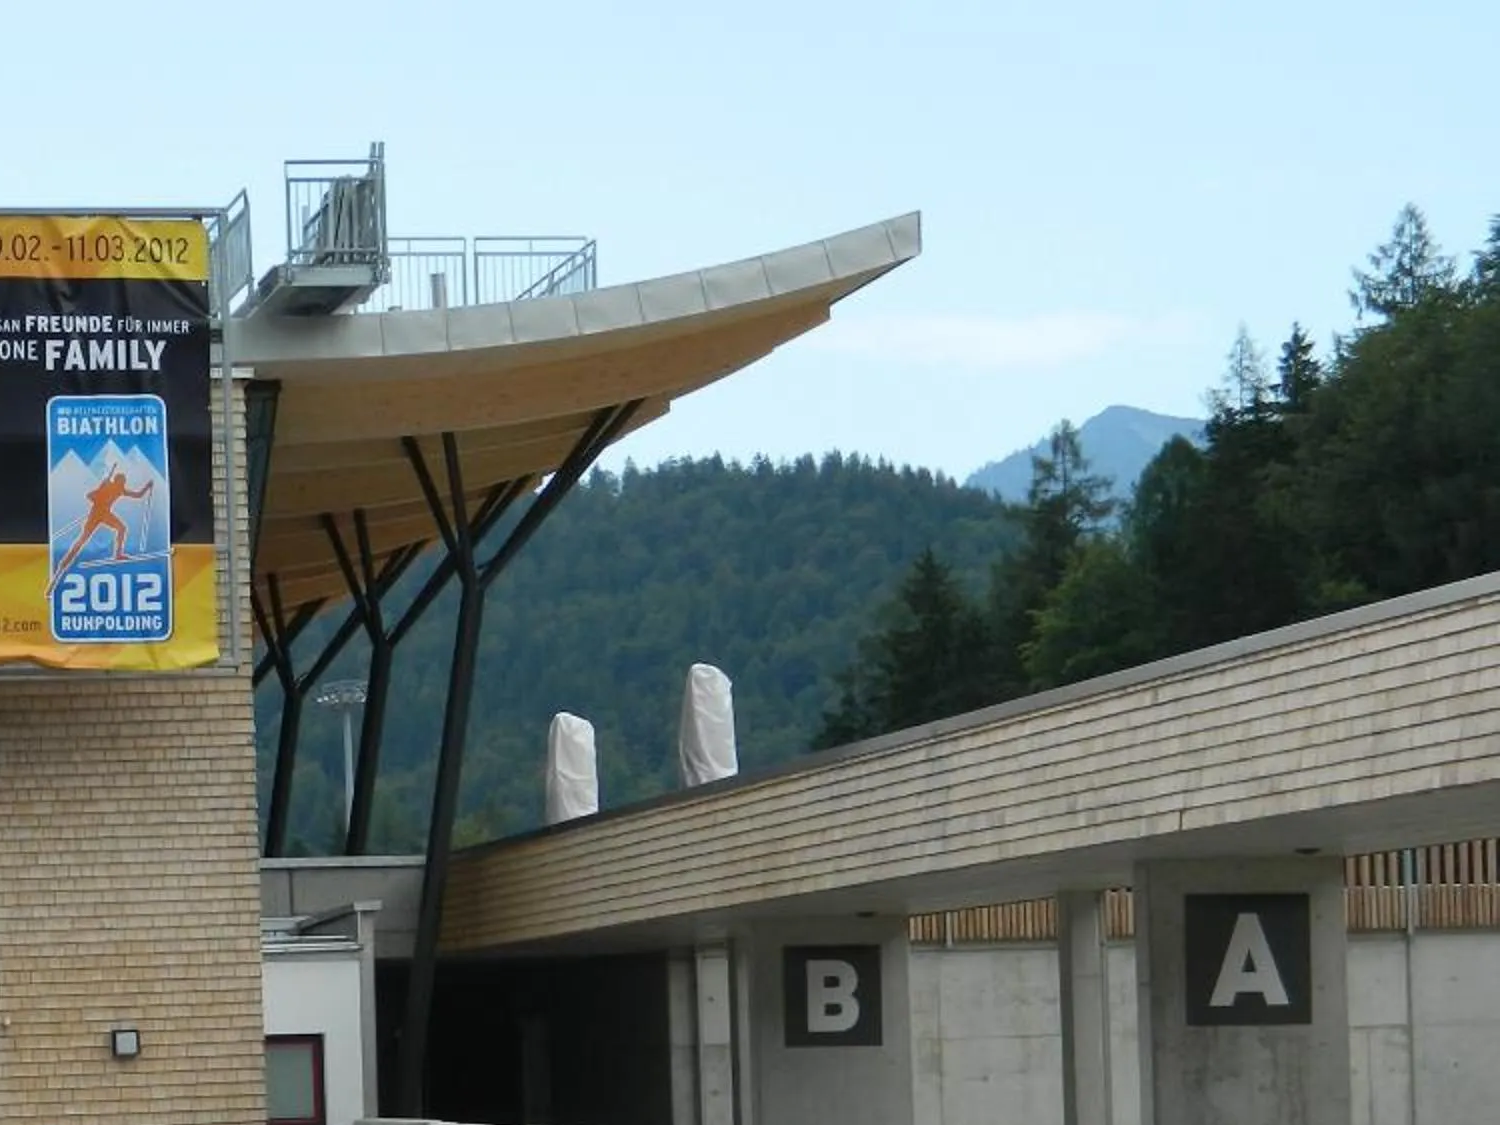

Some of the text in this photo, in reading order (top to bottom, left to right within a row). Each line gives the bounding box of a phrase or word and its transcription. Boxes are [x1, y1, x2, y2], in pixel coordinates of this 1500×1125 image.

[25, 315, 113, 333] FREUNDE
[117, 316, 143, 333] FÜR
[147, 319, 190, 334] IMMER
[0, 339, 38, 361] ONE
[45, 339, 167, 371] FAMILY
[57, 417, 159, 436] BIATHLON
[61, 573, 163, 613] 2012
[61, 615, 163, 632] RUHPOLDING
[1209, 912, 1290, 1006] A
[805, 959, 861, 1033] B
